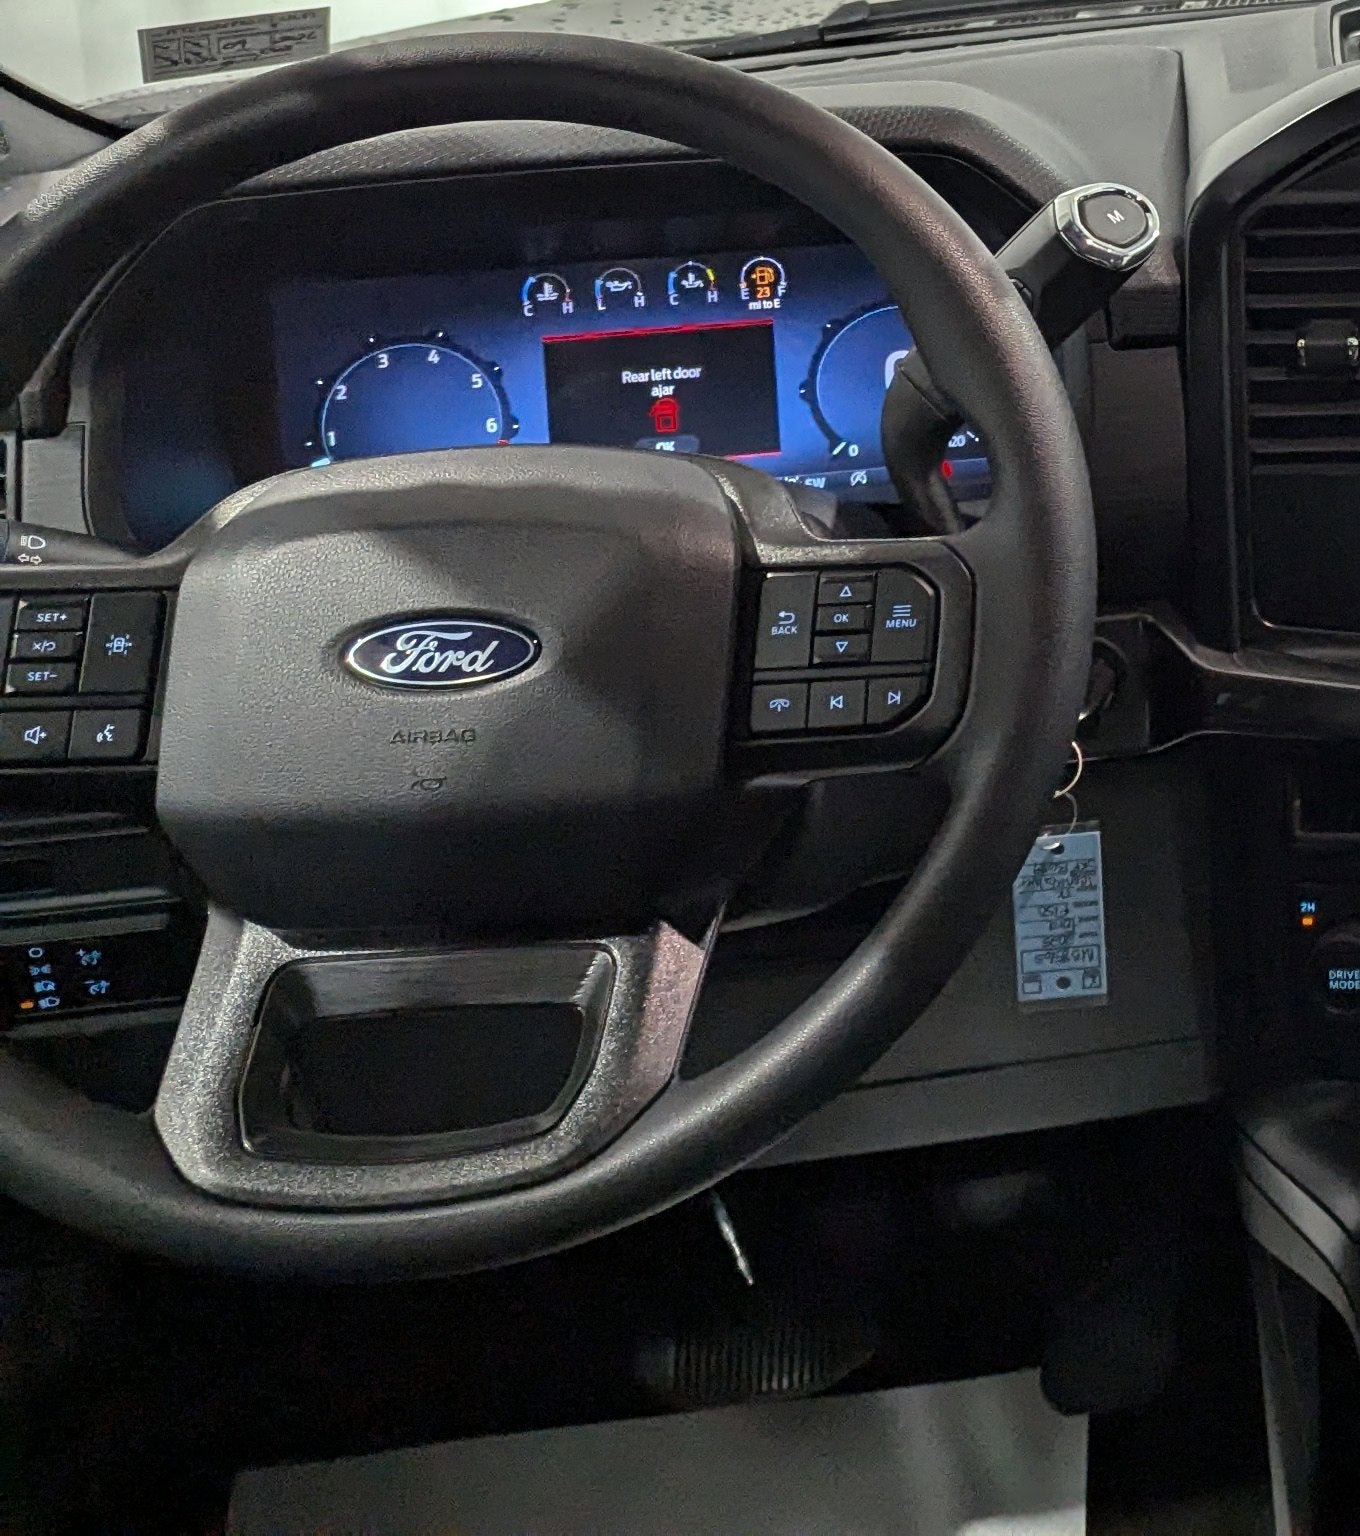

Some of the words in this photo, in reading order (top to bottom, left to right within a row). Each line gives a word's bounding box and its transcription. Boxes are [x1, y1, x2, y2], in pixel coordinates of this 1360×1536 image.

[1107, 210, 1125, 224] M
[708, 291, 718, 302] H
[740, 289, 749, 299] E
[756, 287, 771, 298] 23
[597, 299, 606, 310] L
[634, 296, 645, 307] H
[670, 294, 679, 306] C
[762, 300, 773, 309] to
[774, 299, 781, 308] E
[524, 305, 533, 316] C
[563, 302, 574, 313] H
[378, 354, 389, 369] 3
[428, 350, 440, 364] 4
[621, 369, 650, 384] Rear
[650, 367, 672, 382] left
[673, 366, 701, 380] door
[471, 374, 483, 389] 5
[335, 385, 347, 400] 2
[651, 384, 675, 398] ajar
[485, 419, 498, 433] 6
[327, 431, 336, 446] 1
[848, 444, 858, 457] 0
[36, 612, 67, 623] SET+
[833, 613, 849, 623] OK
[886, 619, 917, 628] MENU
[771, 626, 798, 635] BACK
[380, 630, 500, 674] Ford
[389, 728, 477, 745] AIRBAG
[1299, 901, 1316, 913] 2H
[1328, 970, 1360, 980] DRIVE
[1329, 980, 1360, 990] MODE
